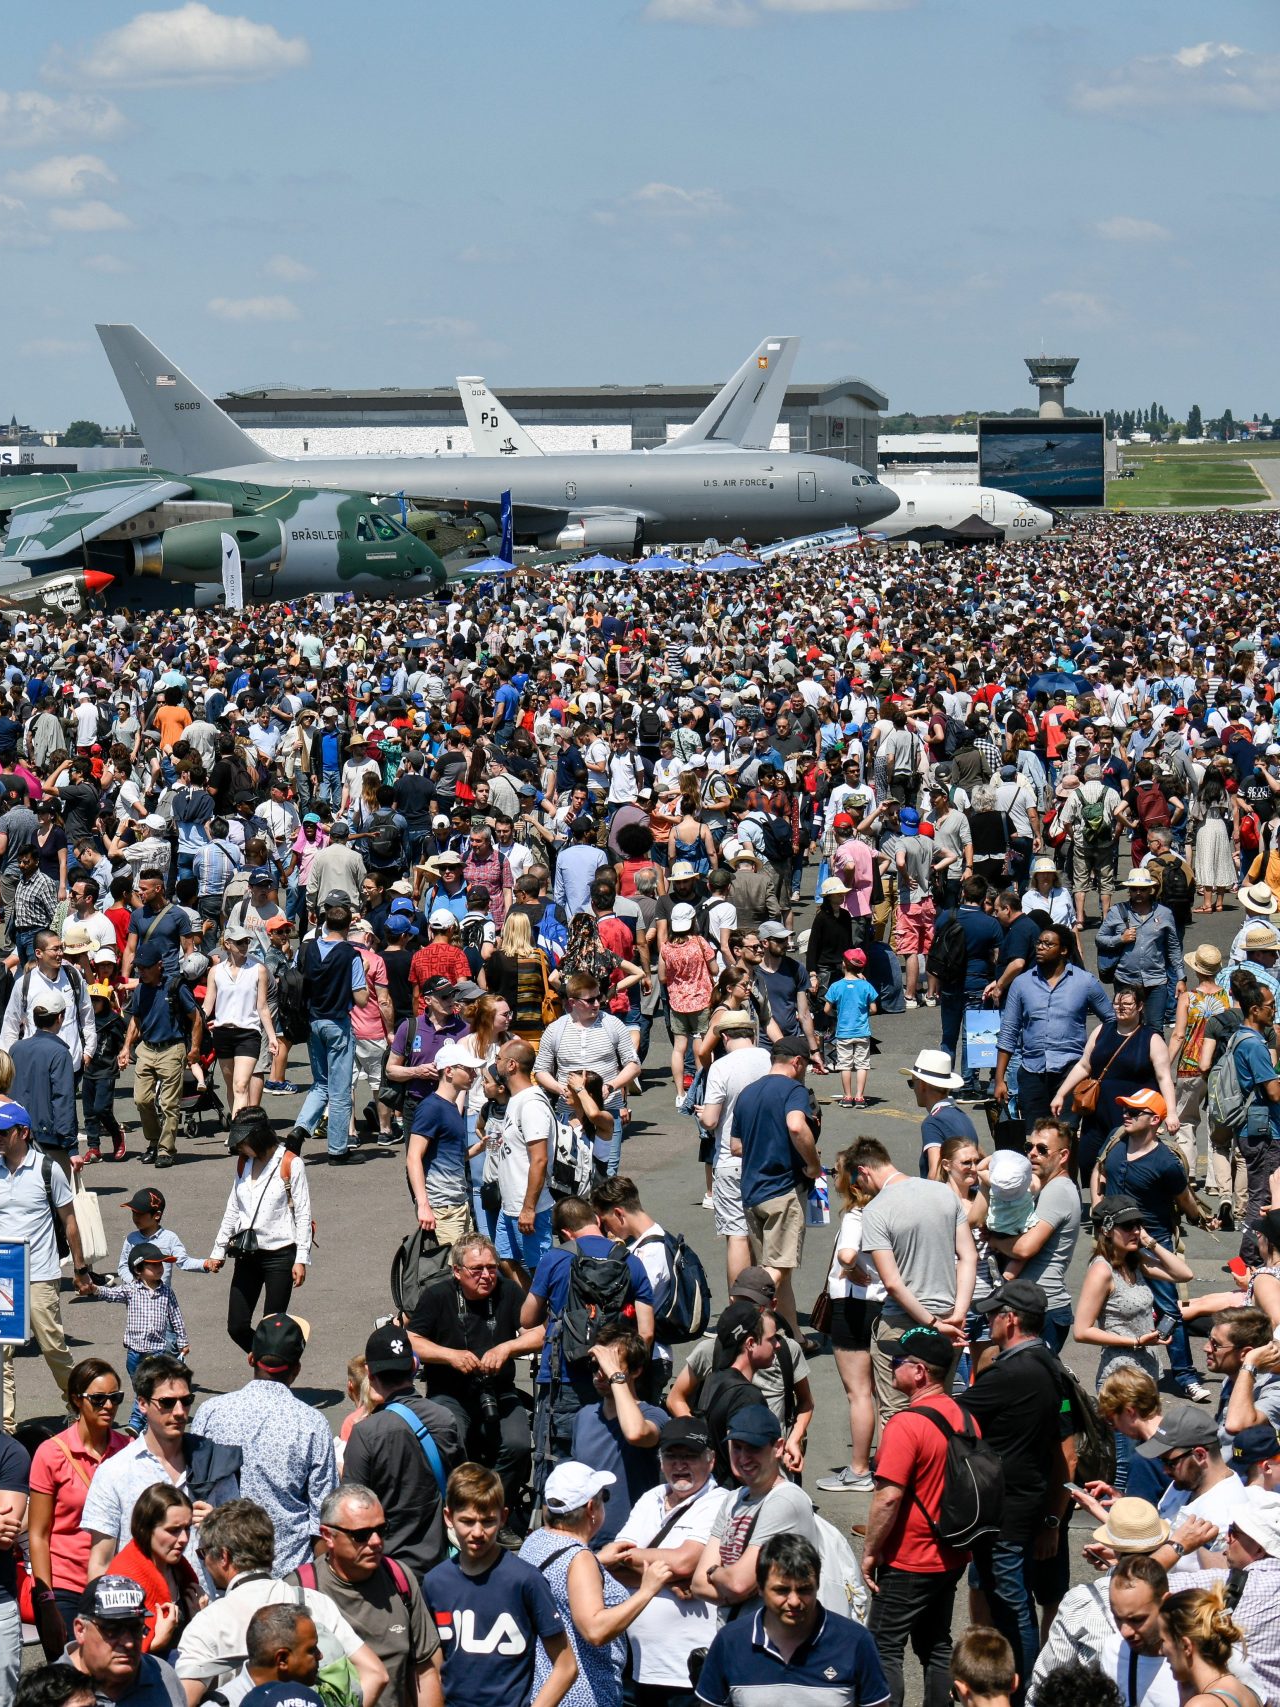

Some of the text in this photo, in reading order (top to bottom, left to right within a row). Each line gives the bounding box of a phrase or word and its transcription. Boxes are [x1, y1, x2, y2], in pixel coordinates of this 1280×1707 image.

[739, 479, 768, 487] FORCE
[1012, 518, 1034, 527] 002
[104, 1592, 141, 1606] RACING
[435, 1610, 526, 1655] FILA
[276, 1697, 318, 1707] AIRBUS
